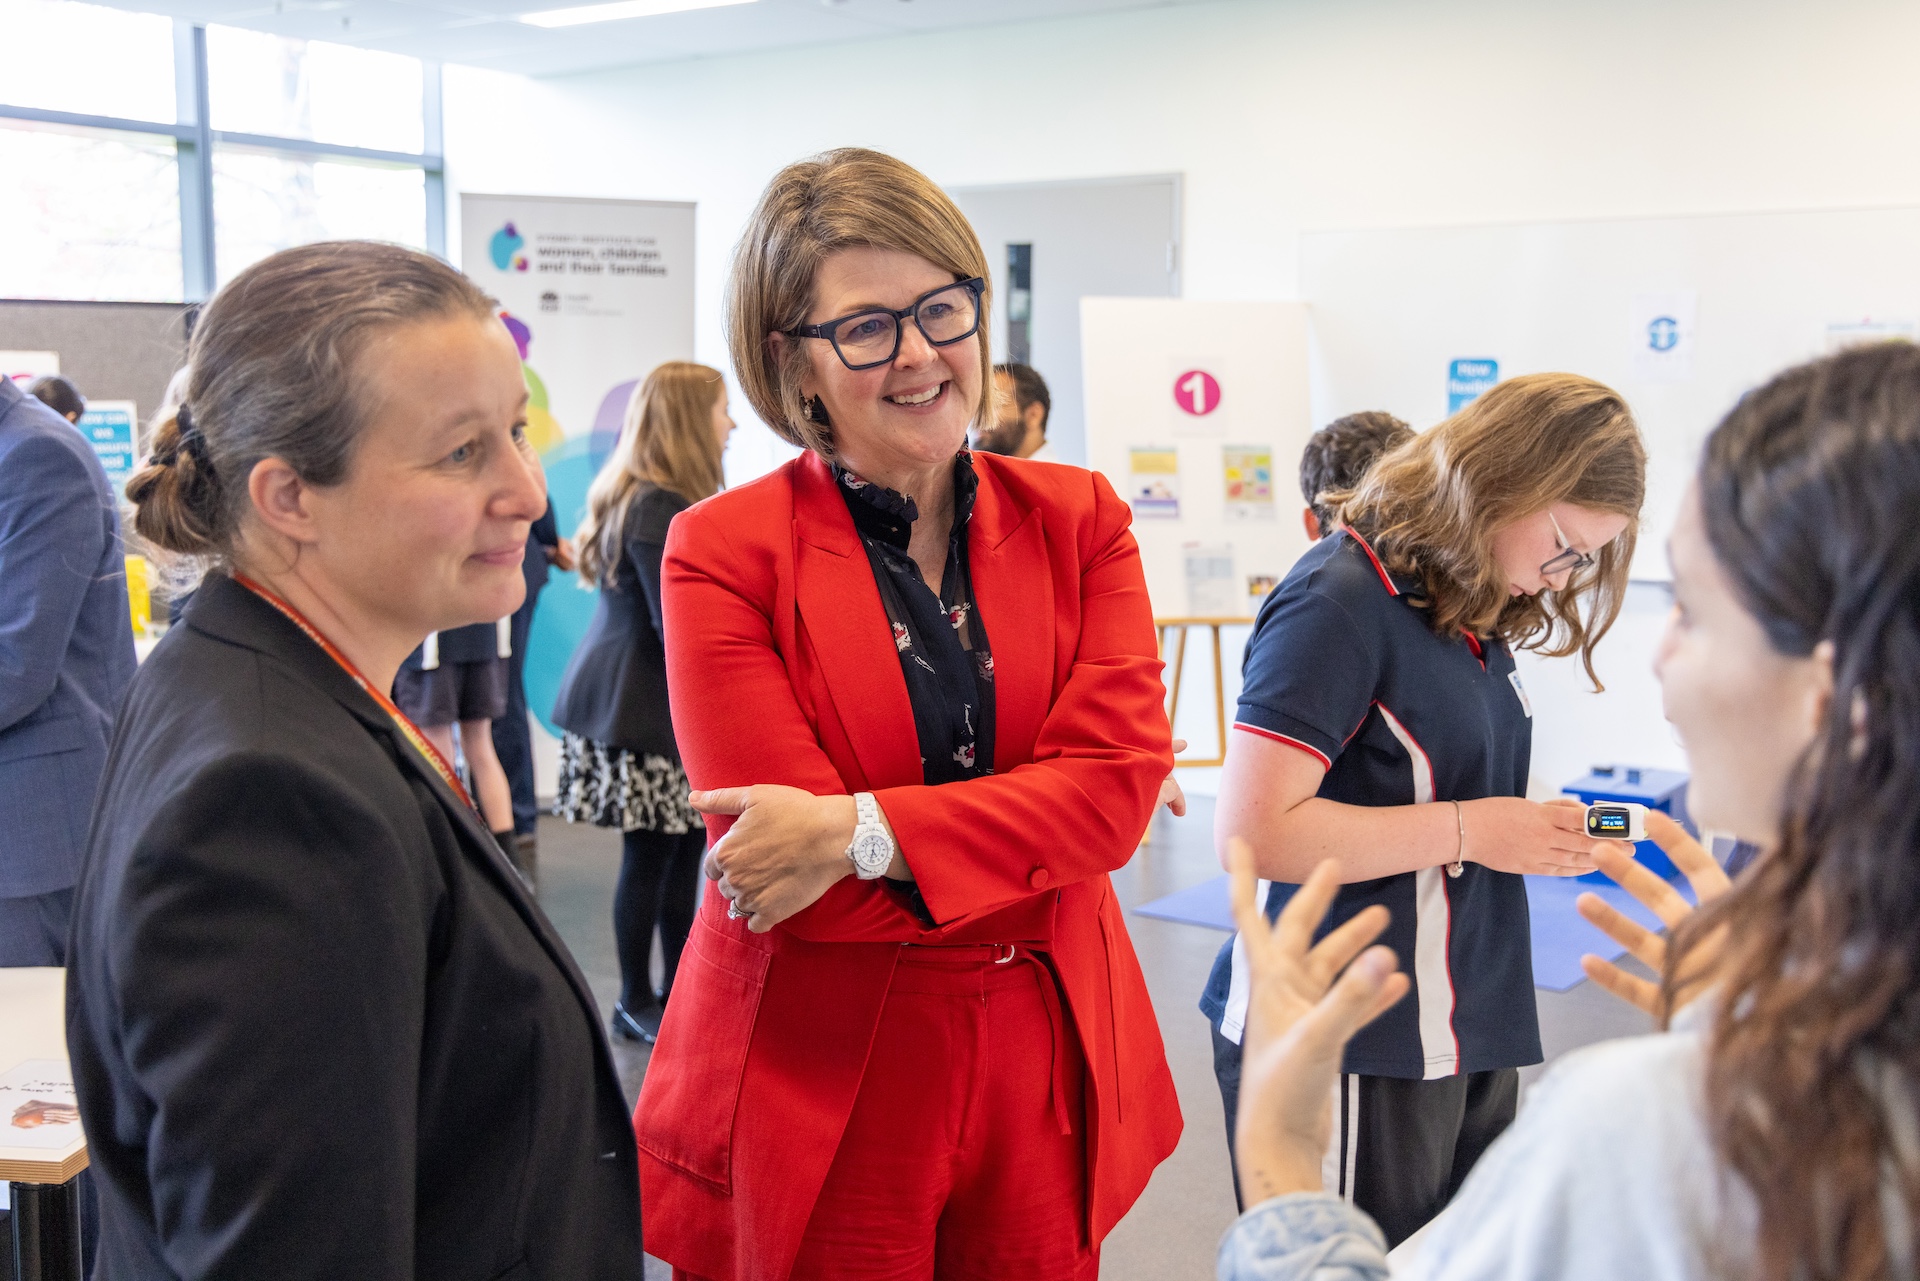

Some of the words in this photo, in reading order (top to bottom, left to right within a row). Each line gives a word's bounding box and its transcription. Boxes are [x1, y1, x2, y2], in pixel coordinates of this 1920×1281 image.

[538, 247, 595, 260] women,
[600, 247, 660, 260] children
[538, 261, 565, 273] and
[571, 261, 603, 274] their
[609, 263, 668, 276] families
[1457, 363, 1491, 377] How
[1181, 371, 1205, 414] 1
[425, 747, 453, 782] LOCAL
